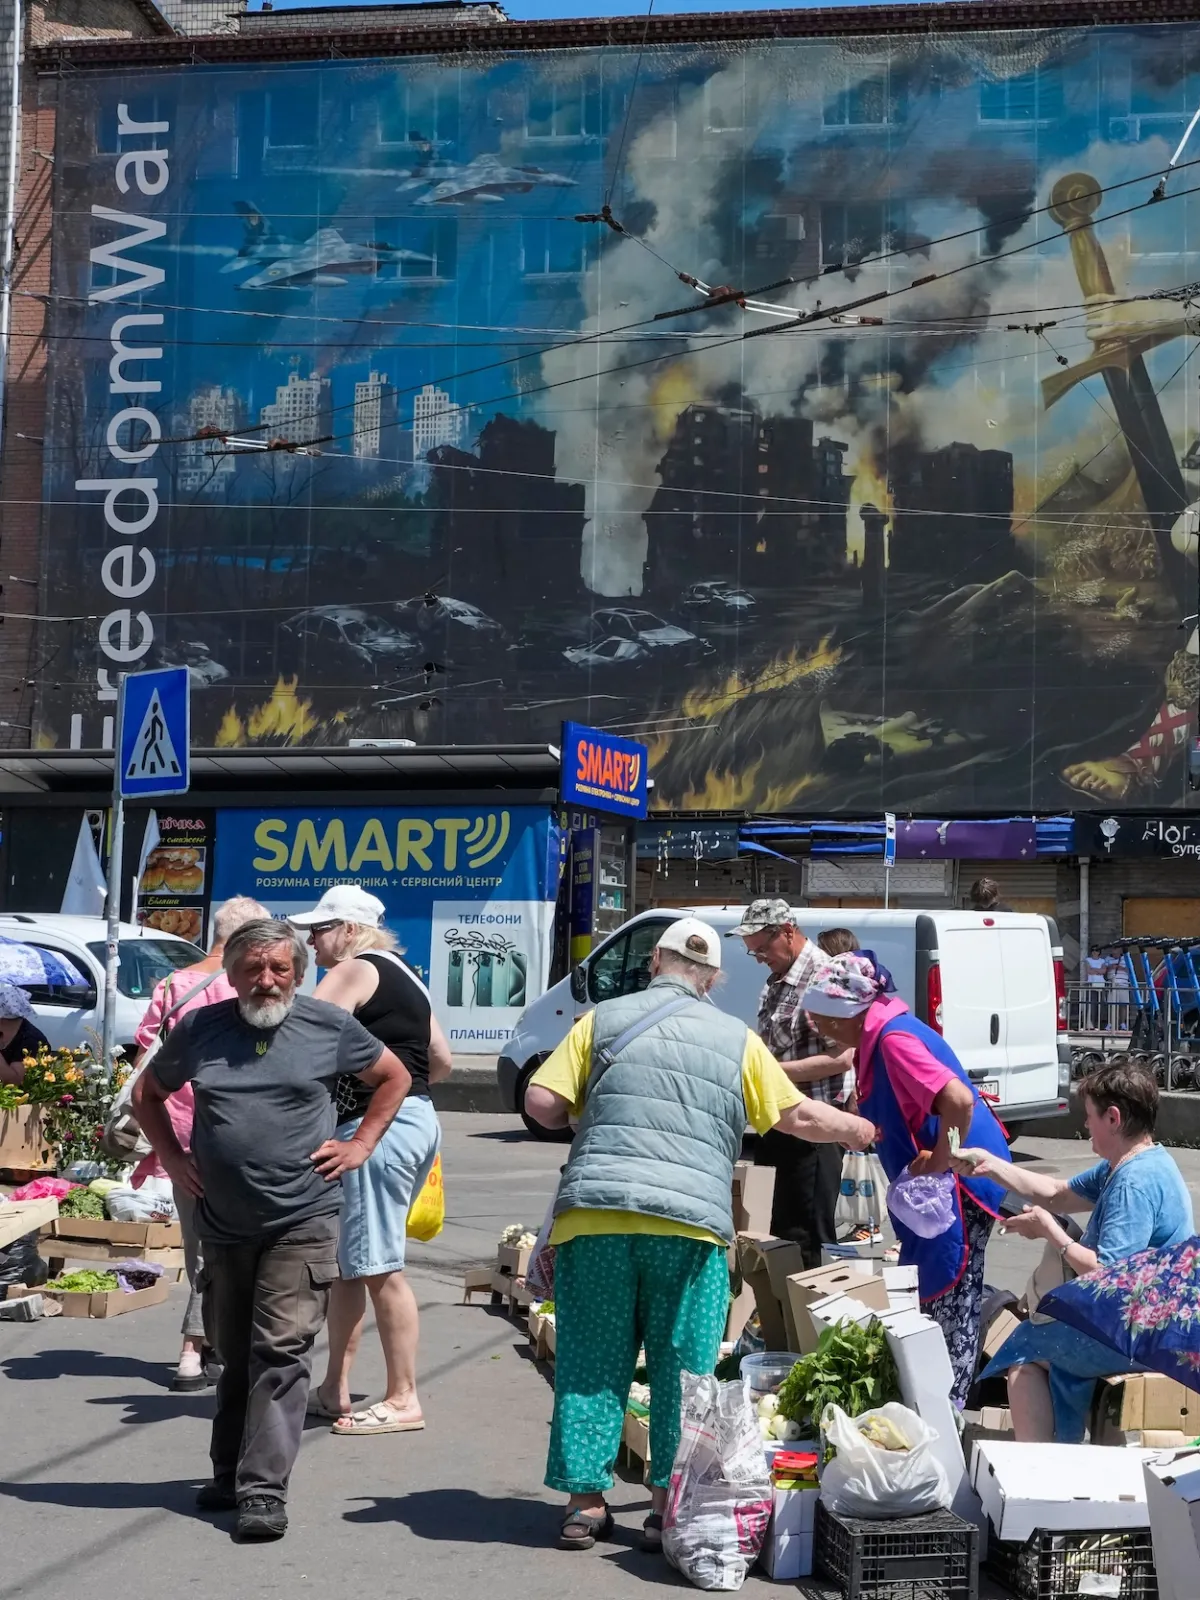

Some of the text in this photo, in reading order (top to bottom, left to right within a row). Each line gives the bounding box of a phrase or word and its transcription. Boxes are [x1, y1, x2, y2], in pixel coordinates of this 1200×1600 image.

[577, 740, 631, 792] SMART
[253, 819, 470, 872] SMART
[256, 877, 310, 887] РОЗУМНА
[314, 877, 388, 887] ЕЛЕКТРОНІКА
[401, 875, 463, 887] СЕРВІСНИЙ
[466, 877, 502, 889] ЦЕНТР
[458, 914, 522, 924] ТЕЛЕФОНИ
[450, 1029, 515, 1040] ПЛАНШЕТ
